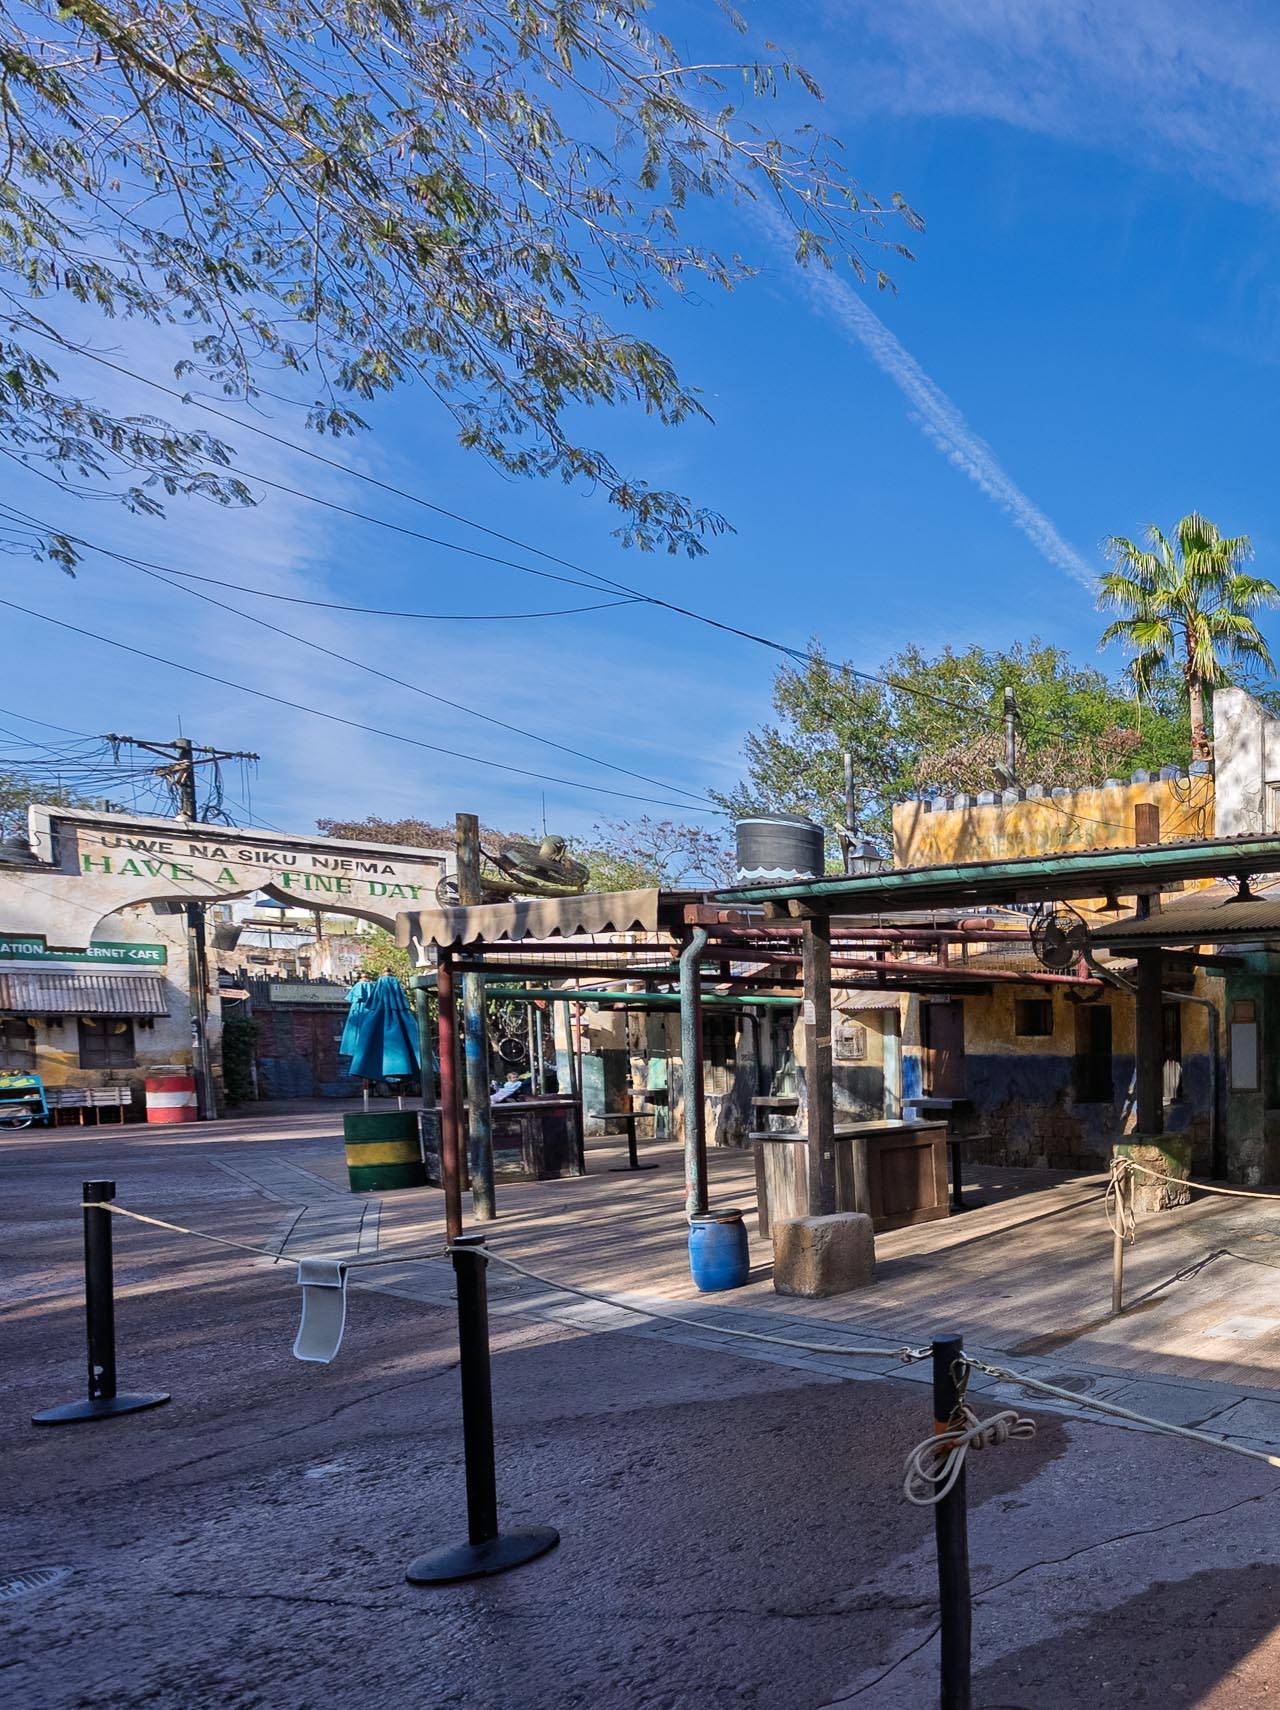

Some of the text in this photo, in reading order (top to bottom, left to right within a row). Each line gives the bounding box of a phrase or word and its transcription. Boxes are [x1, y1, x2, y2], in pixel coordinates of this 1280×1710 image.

[81, 853, 423, 899] HAVE A FINE DAY
[101, 836, 396, 876] UWE NA SIKU NJEMA
